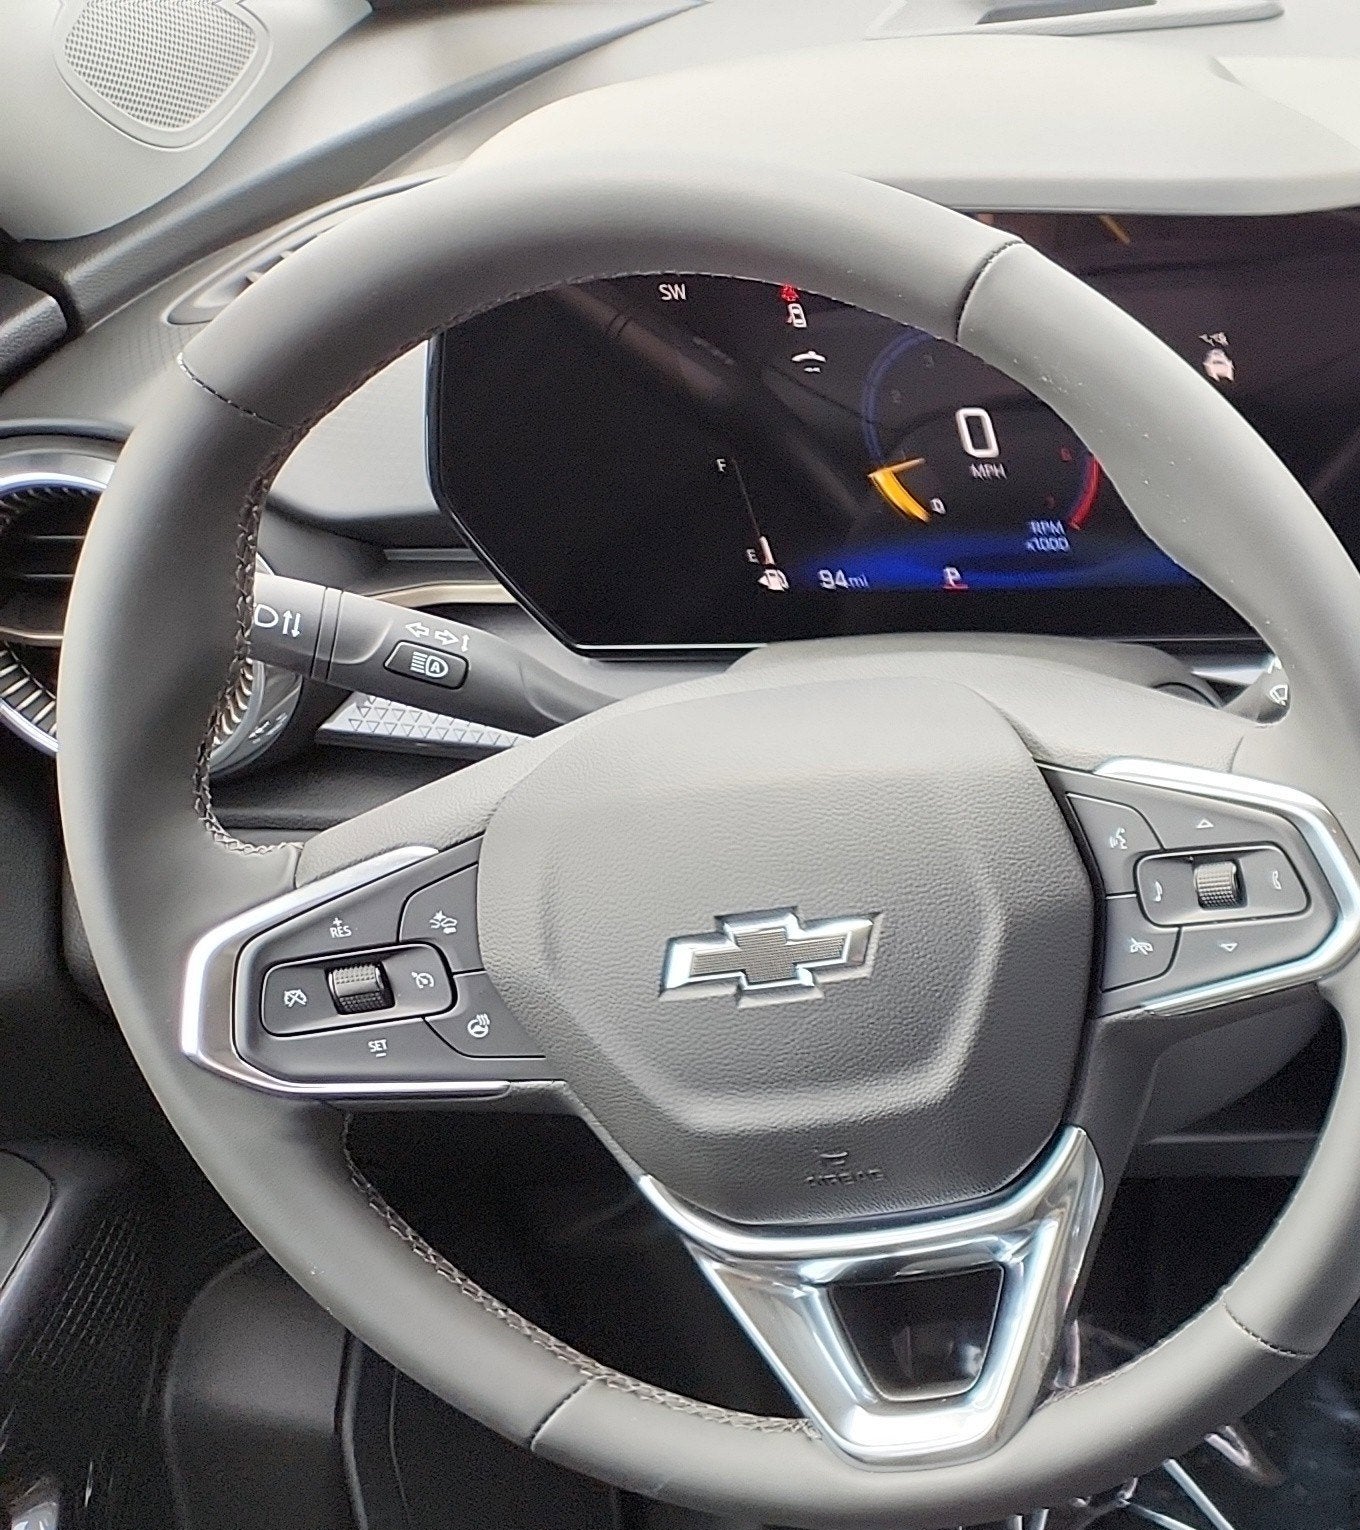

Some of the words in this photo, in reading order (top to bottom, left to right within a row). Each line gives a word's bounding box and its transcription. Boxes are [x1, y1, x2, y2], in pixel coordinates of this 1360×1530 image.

[658, 283, 687, 301] SW
[954, 406, 1000, 459] 0
[716, 458, 728, 472] F
[968, 462, 1007, 480] MPH
[1029, 519, 1067, 535] RPM
[943, 566, 962, 587] P
[329, 925, 352, 939] RES
[367, 1039, 388, 1052] SET
